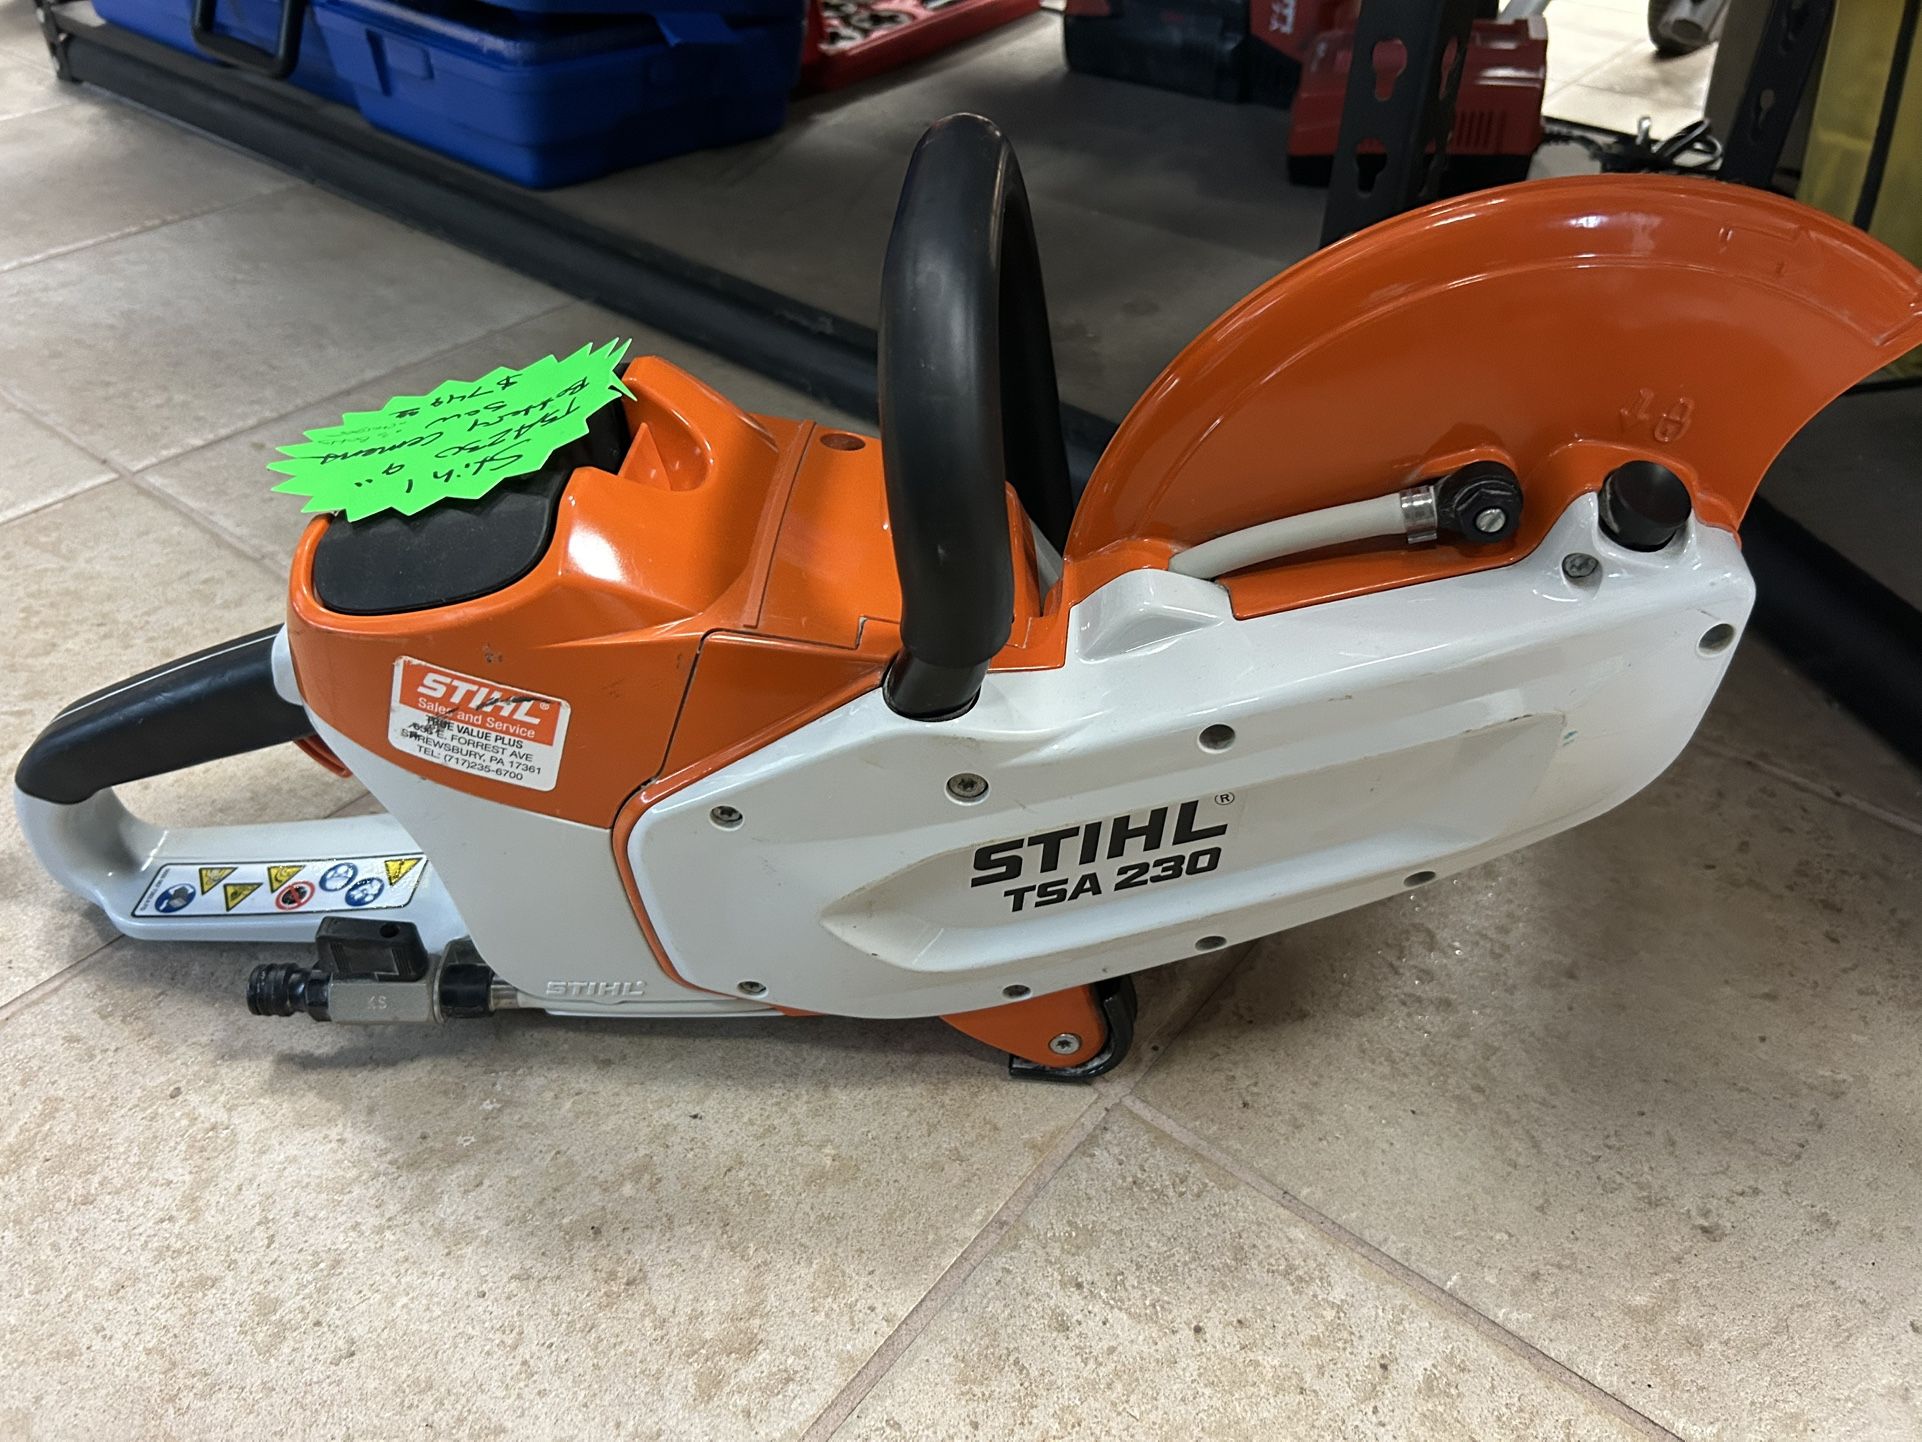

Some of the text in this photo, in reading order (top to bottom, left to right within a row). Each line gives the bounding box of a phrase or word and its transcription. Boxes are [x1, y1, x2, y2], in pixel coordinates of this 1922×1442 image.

[417, 672, 541, 725] STIHL
[418, 697, 536, 738] Sales and Service
[451, 734, 507, 755] FORREST
[510, 750, 533, 762] AVE
[457, 724, 492, 742] VALUE
[495, 734, 523, 749] PLUS
[417, 744, 523, 780] TEL: (717)235-6700
[489, 755, 505, 766] PA
[509, 760, 541, 775] 17361
[971, 800, 1228, 888] STIHL
[1003, 847, 1222, 912] TSA 230
[546, 981, 645, 996] STIHL
